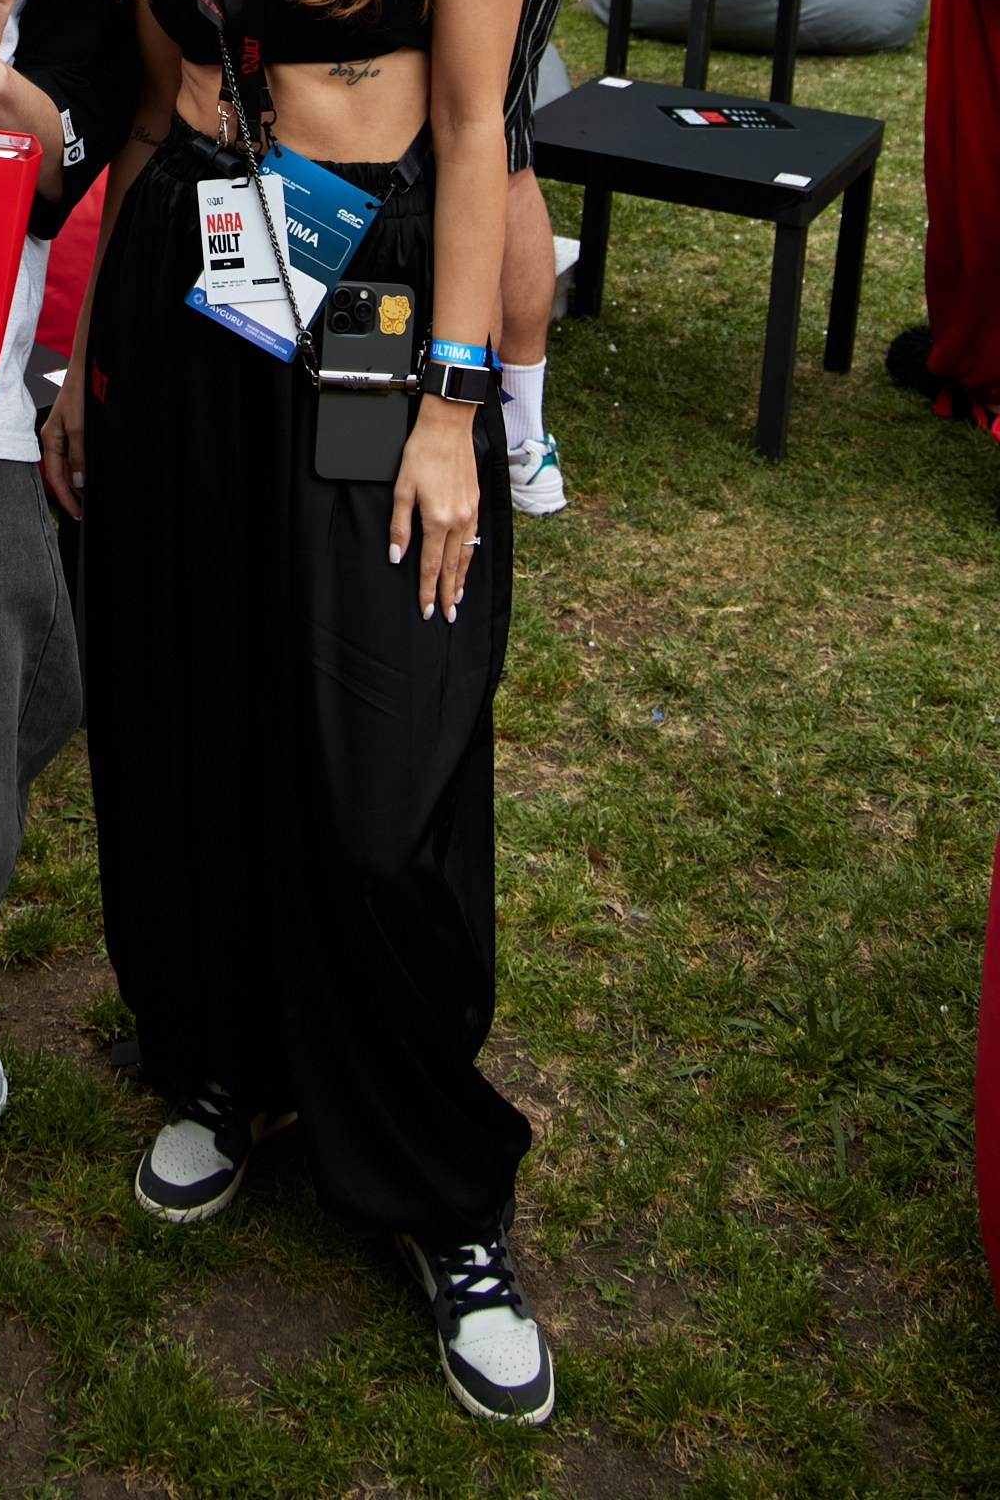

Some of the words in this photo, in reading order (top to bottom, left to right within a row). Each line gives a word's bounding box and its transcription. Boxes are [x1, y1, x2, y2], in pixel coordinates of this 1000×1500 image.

[241, 36, 261, 74] KULT
[206, 212, 243, 233] NARA
[286, 217, 319, 248] TIMA
[208, 233, 241, 255] KULT
[432, 343, 472, 361] ULTIMA
